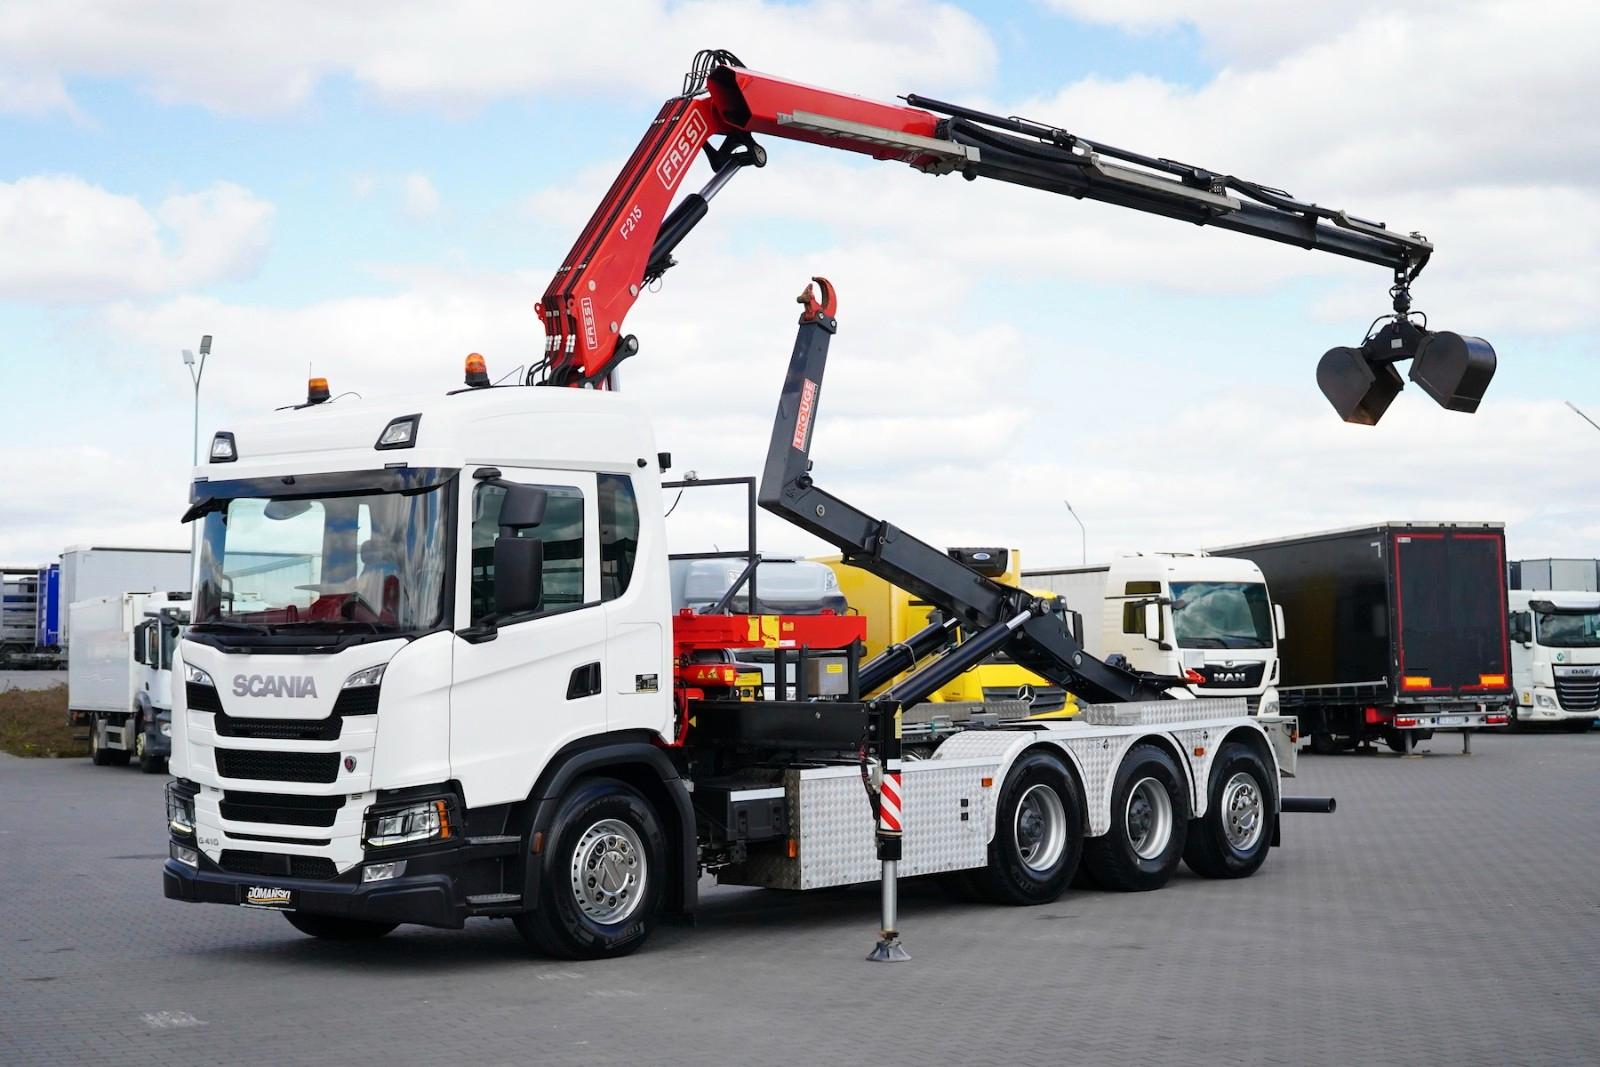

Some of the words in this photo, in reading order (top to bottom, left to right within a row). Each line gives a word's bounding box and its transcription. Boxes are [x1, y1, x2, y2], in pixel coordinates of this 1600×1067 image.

[662, 117, 702, 181] FASSI
[620, 204, 642, 240] F215
[583, 302, 596, 345] FASSI
[795, 381, 815, 449] LEROUGE
[232, 674, 318, 698] SCANIA
[1213, 672, 1246, 682] MAN
